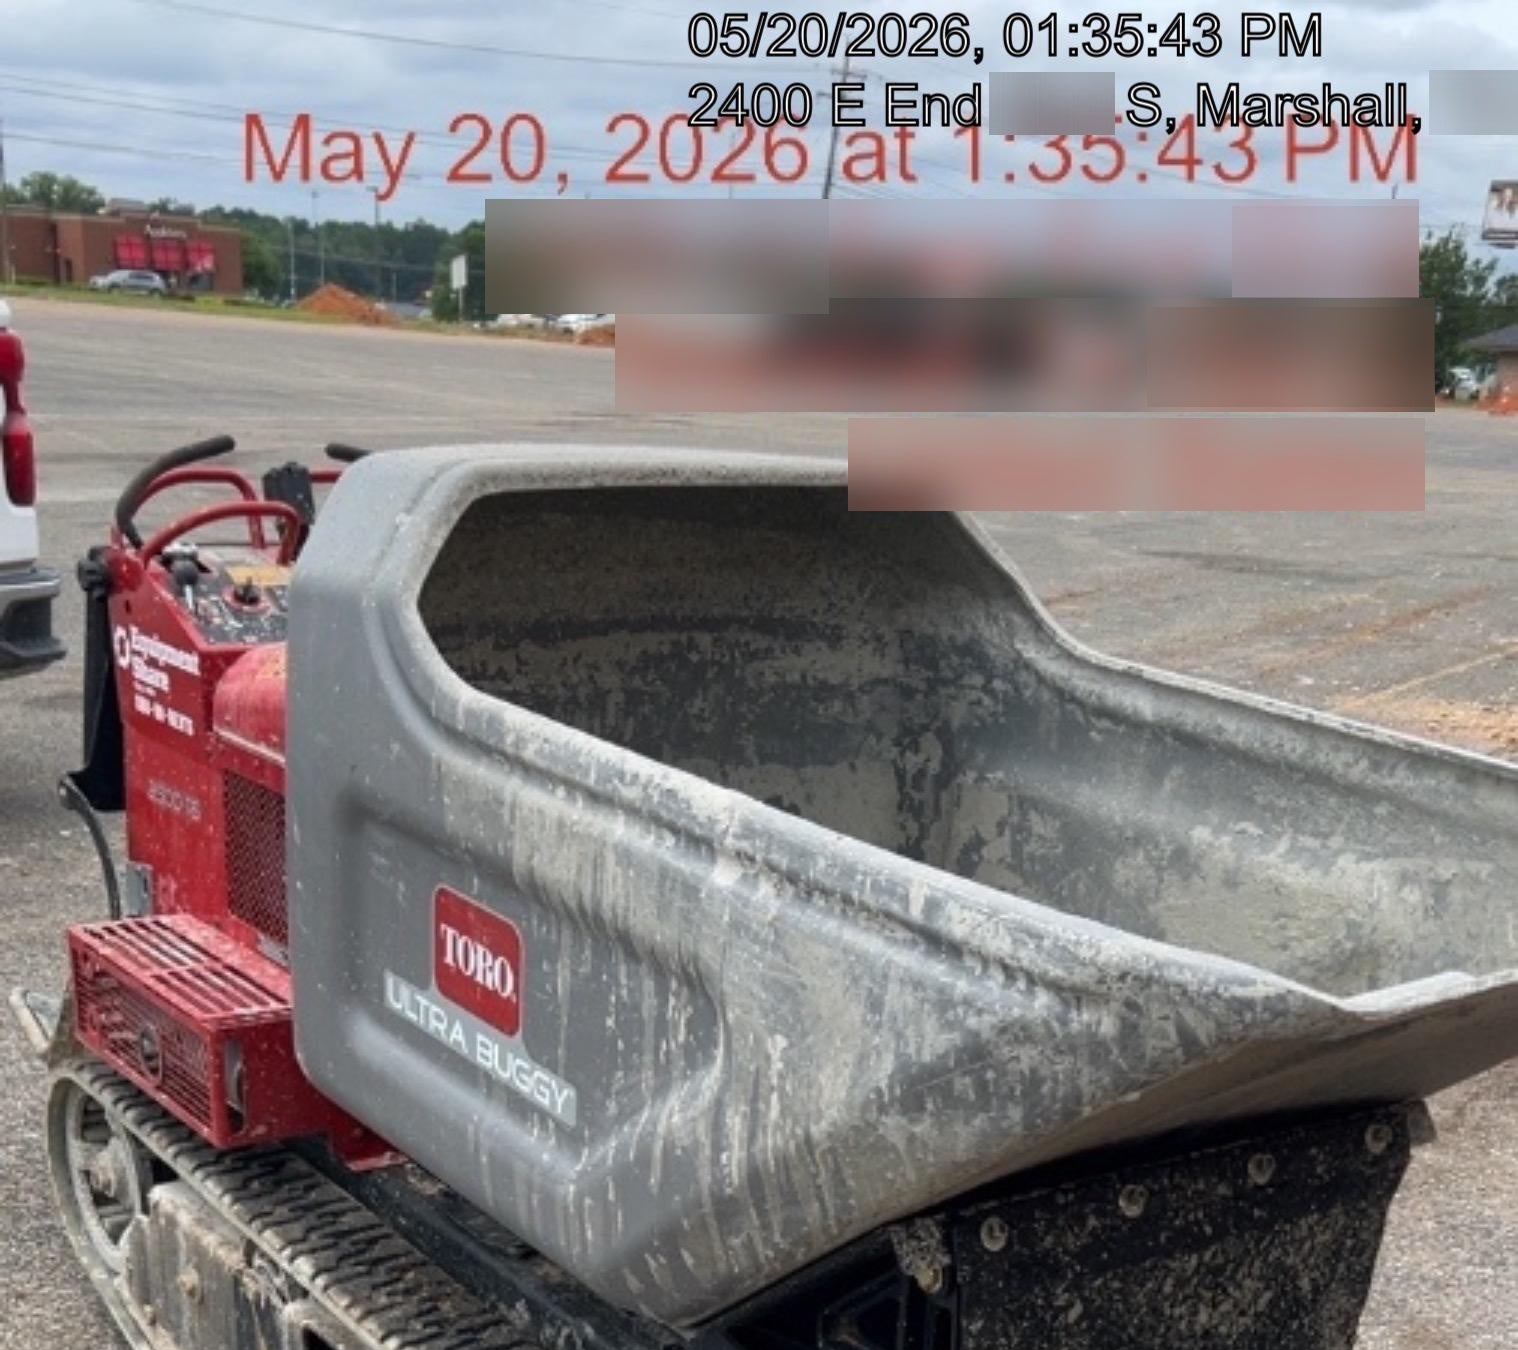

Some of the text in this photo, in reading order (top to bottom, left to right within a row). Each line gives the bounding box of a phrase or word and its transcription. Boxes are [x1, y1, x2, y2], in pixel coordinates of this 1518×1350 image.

[441, 923, 514, 998] TORO
[385, 975, 569, 1114] ULTRA BUGGY
